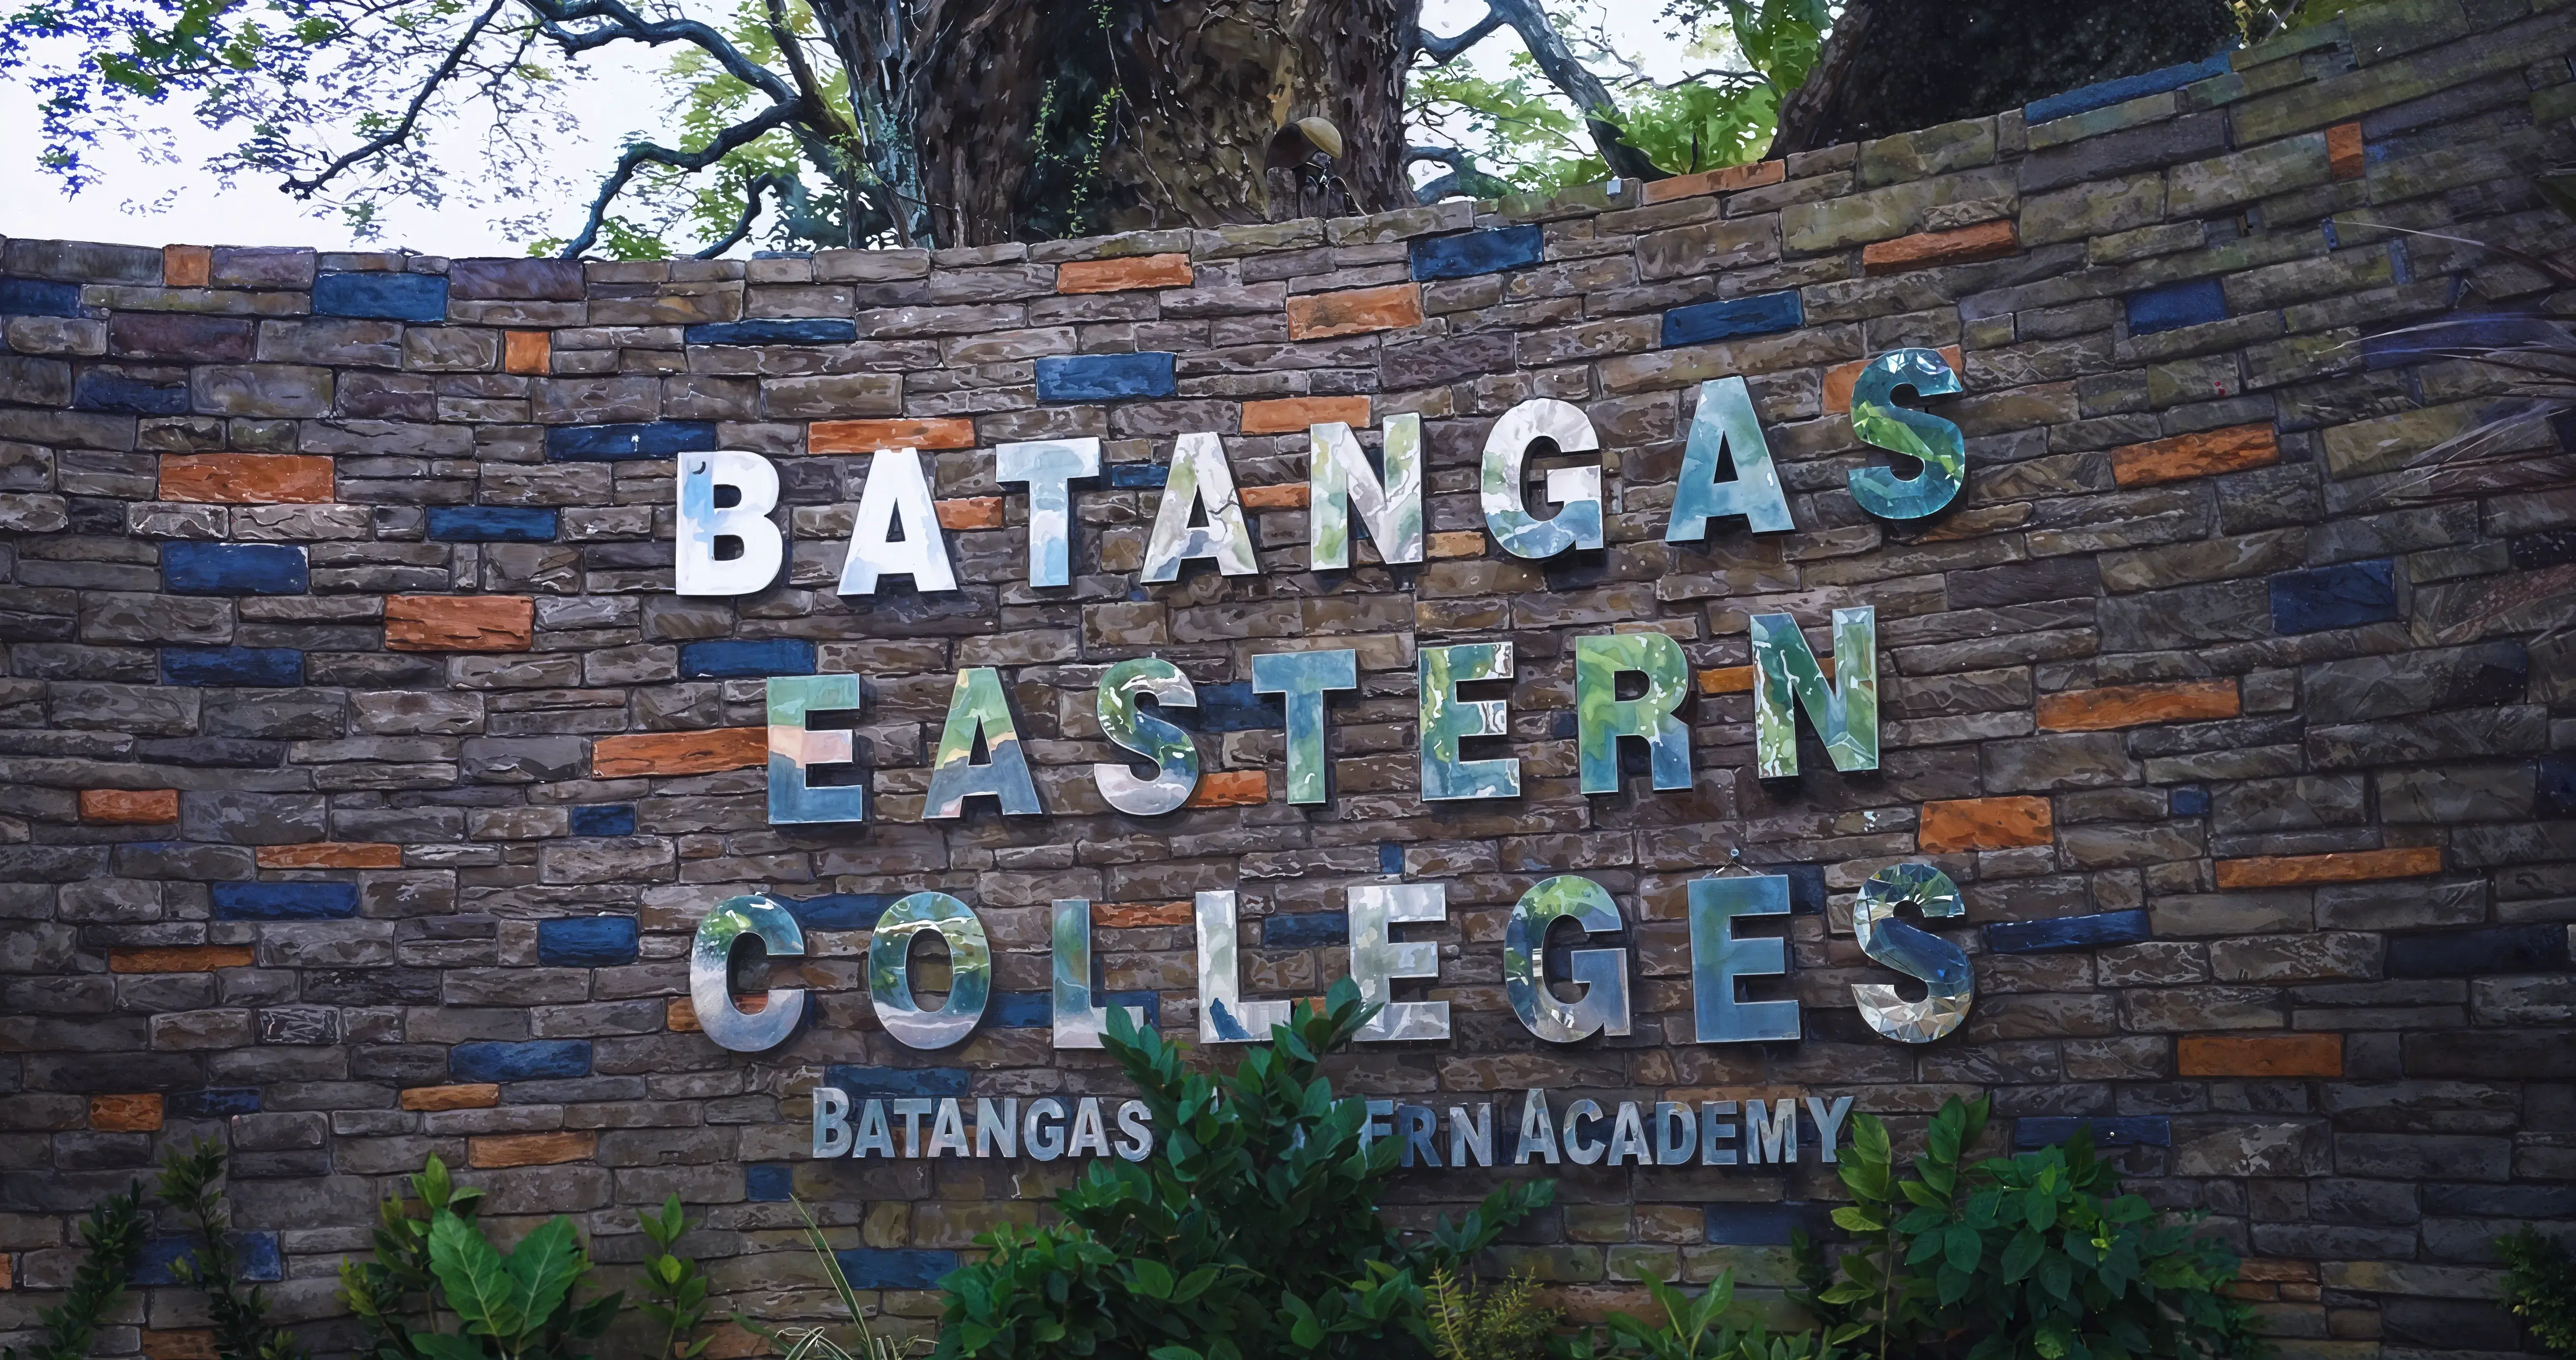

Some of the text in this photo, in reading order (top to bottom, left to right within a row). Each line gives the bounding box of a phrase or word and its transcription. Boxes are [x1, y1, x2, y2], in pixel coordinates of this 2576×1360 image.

[674, 348, 1966, 596] BATANGAS
[767, 607, 1878, 825] EASTERN
[690, 863, 1976, 1051] COLLEGES
[813, 1087, 1153, 1161] BATANGAS
[1514, 1087, 1855, 1166] ACADEMY
